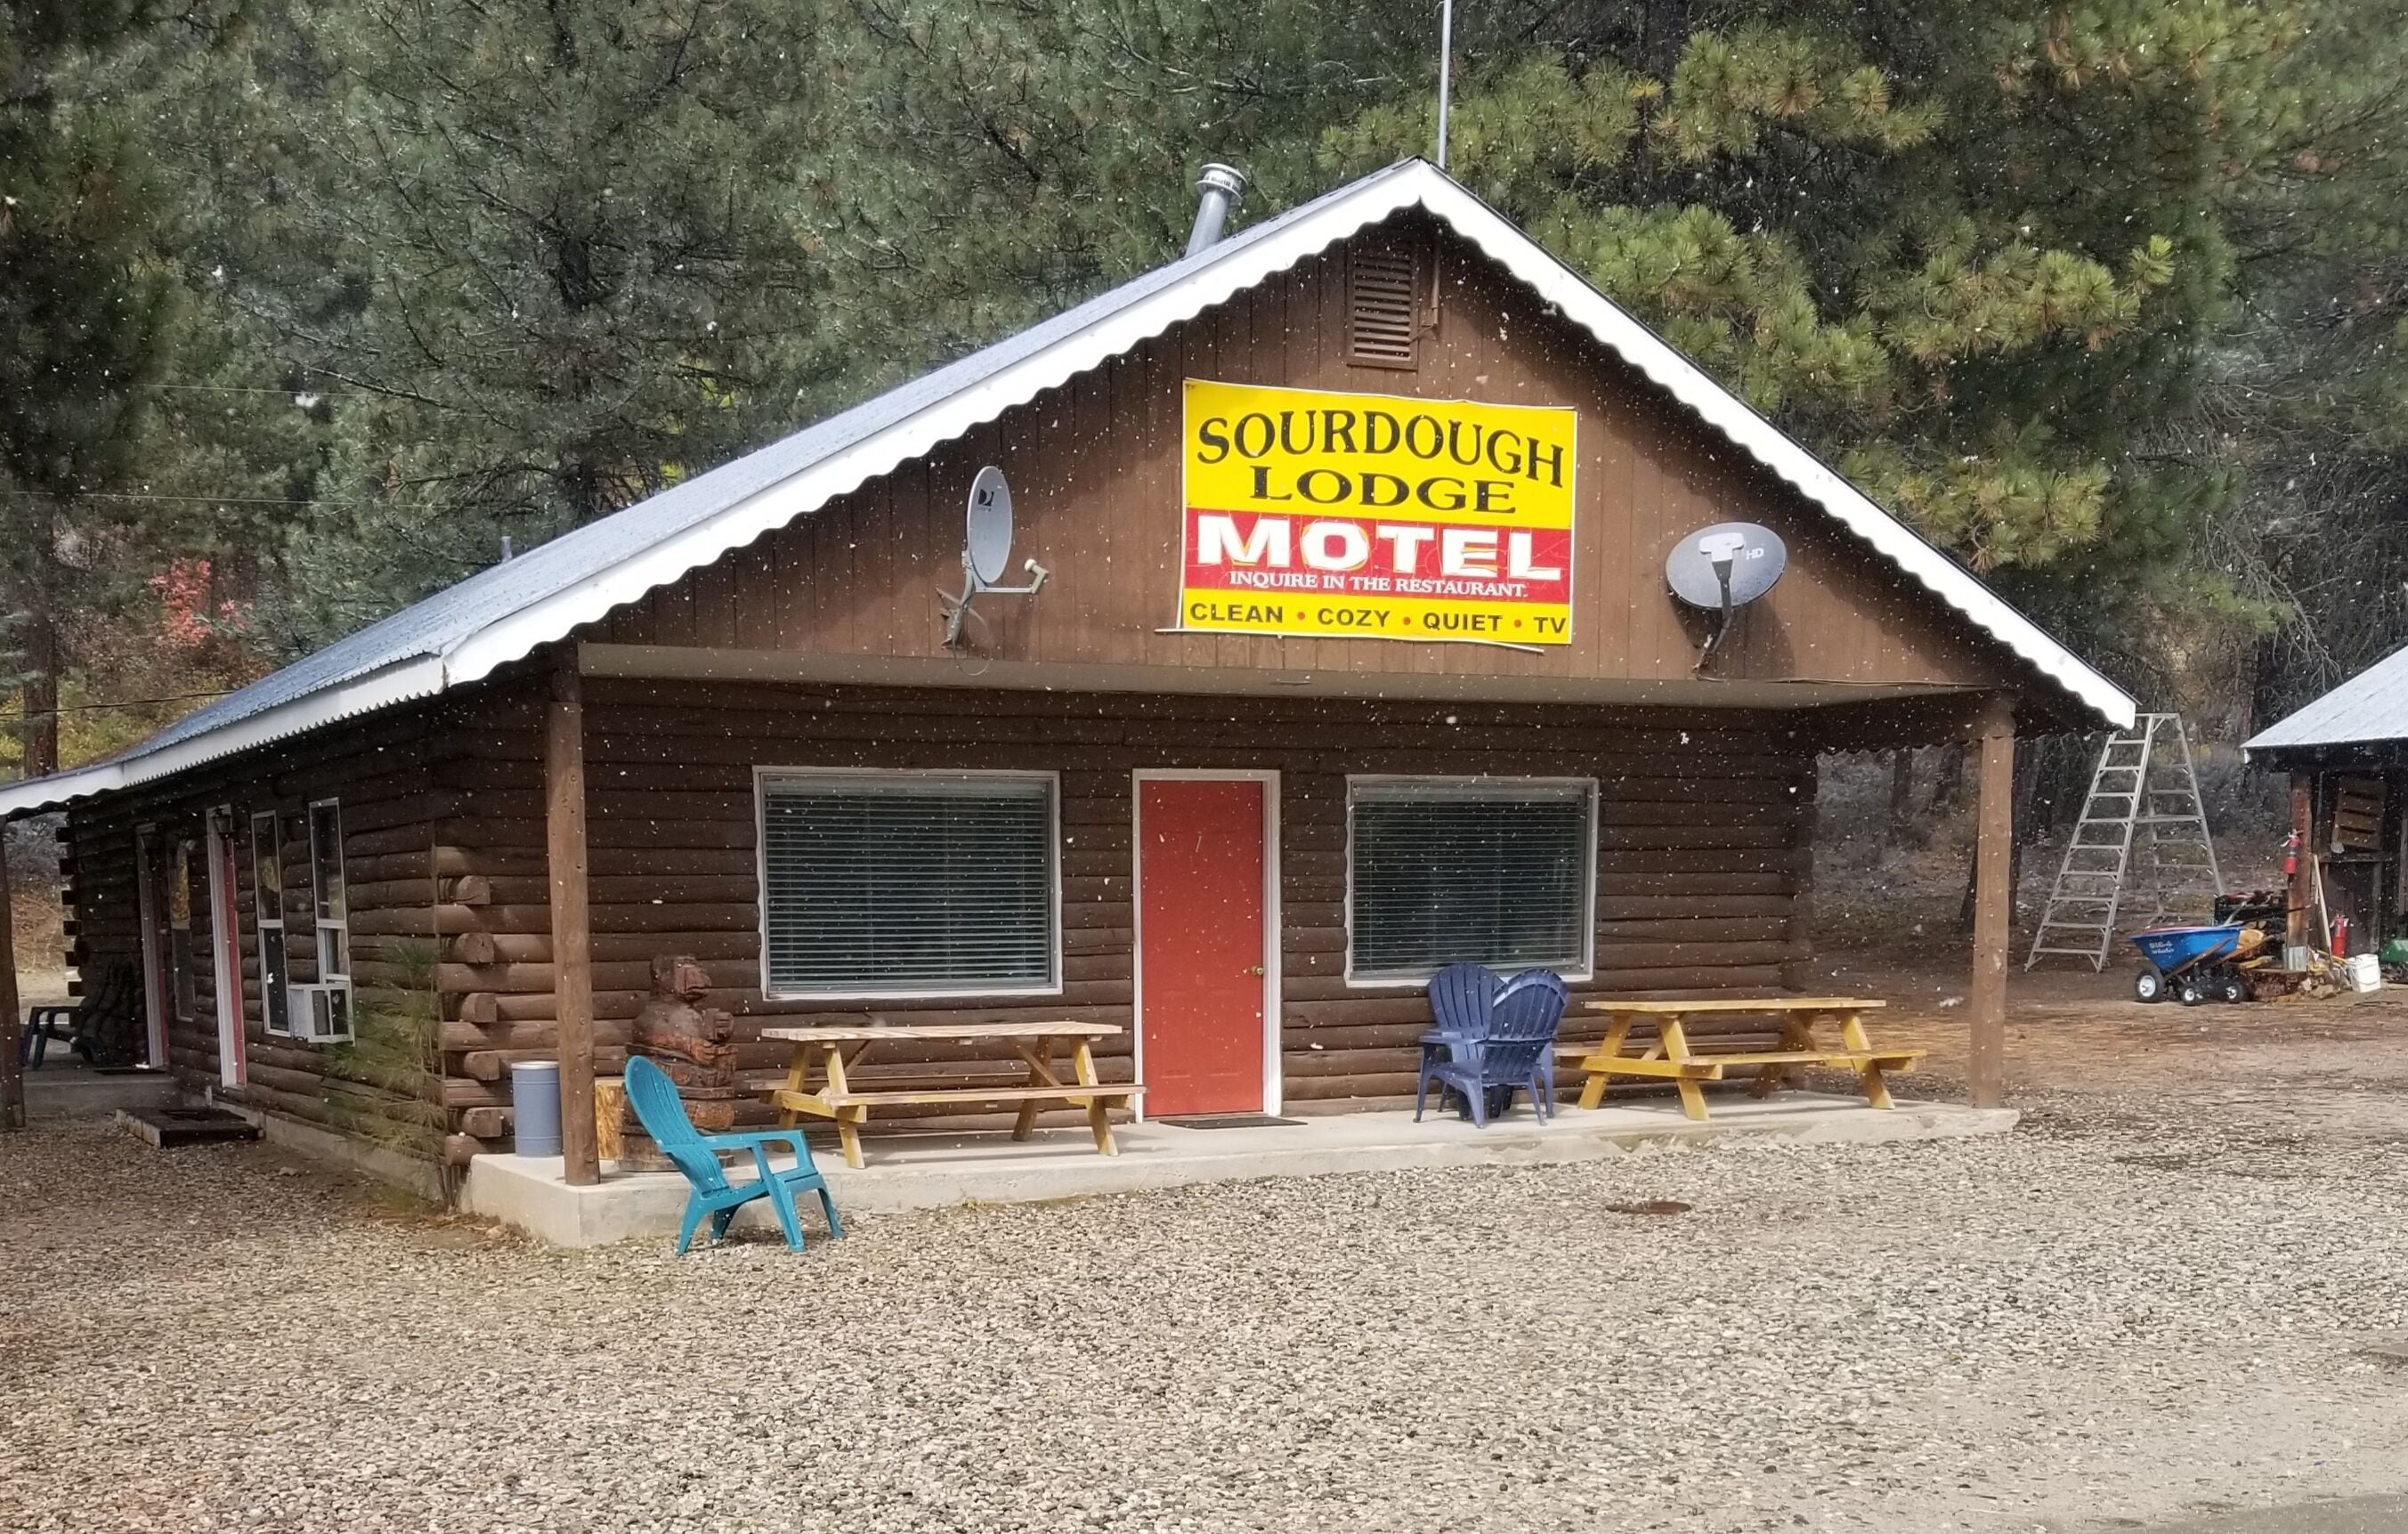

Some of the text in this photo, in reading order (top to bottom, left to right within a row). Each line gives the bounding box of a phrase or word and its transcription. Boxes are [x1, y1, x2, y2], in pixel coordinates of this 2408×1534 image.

[1197, 410, 1563, 487] SOURDOUGH
[1250, 466, 1516, 513] LODGE
[1197, 514, 1561, 580] MOTEL
[1746, 548, 1764, 560] HD
[1229, 571, 1318, 588] INQUIRE
[1323, 575, 1345, 589] IN
[1350, 576, 1390, 591] THE
[1190, 603, 1567, 633] CLEAN COZY QUIET TV
